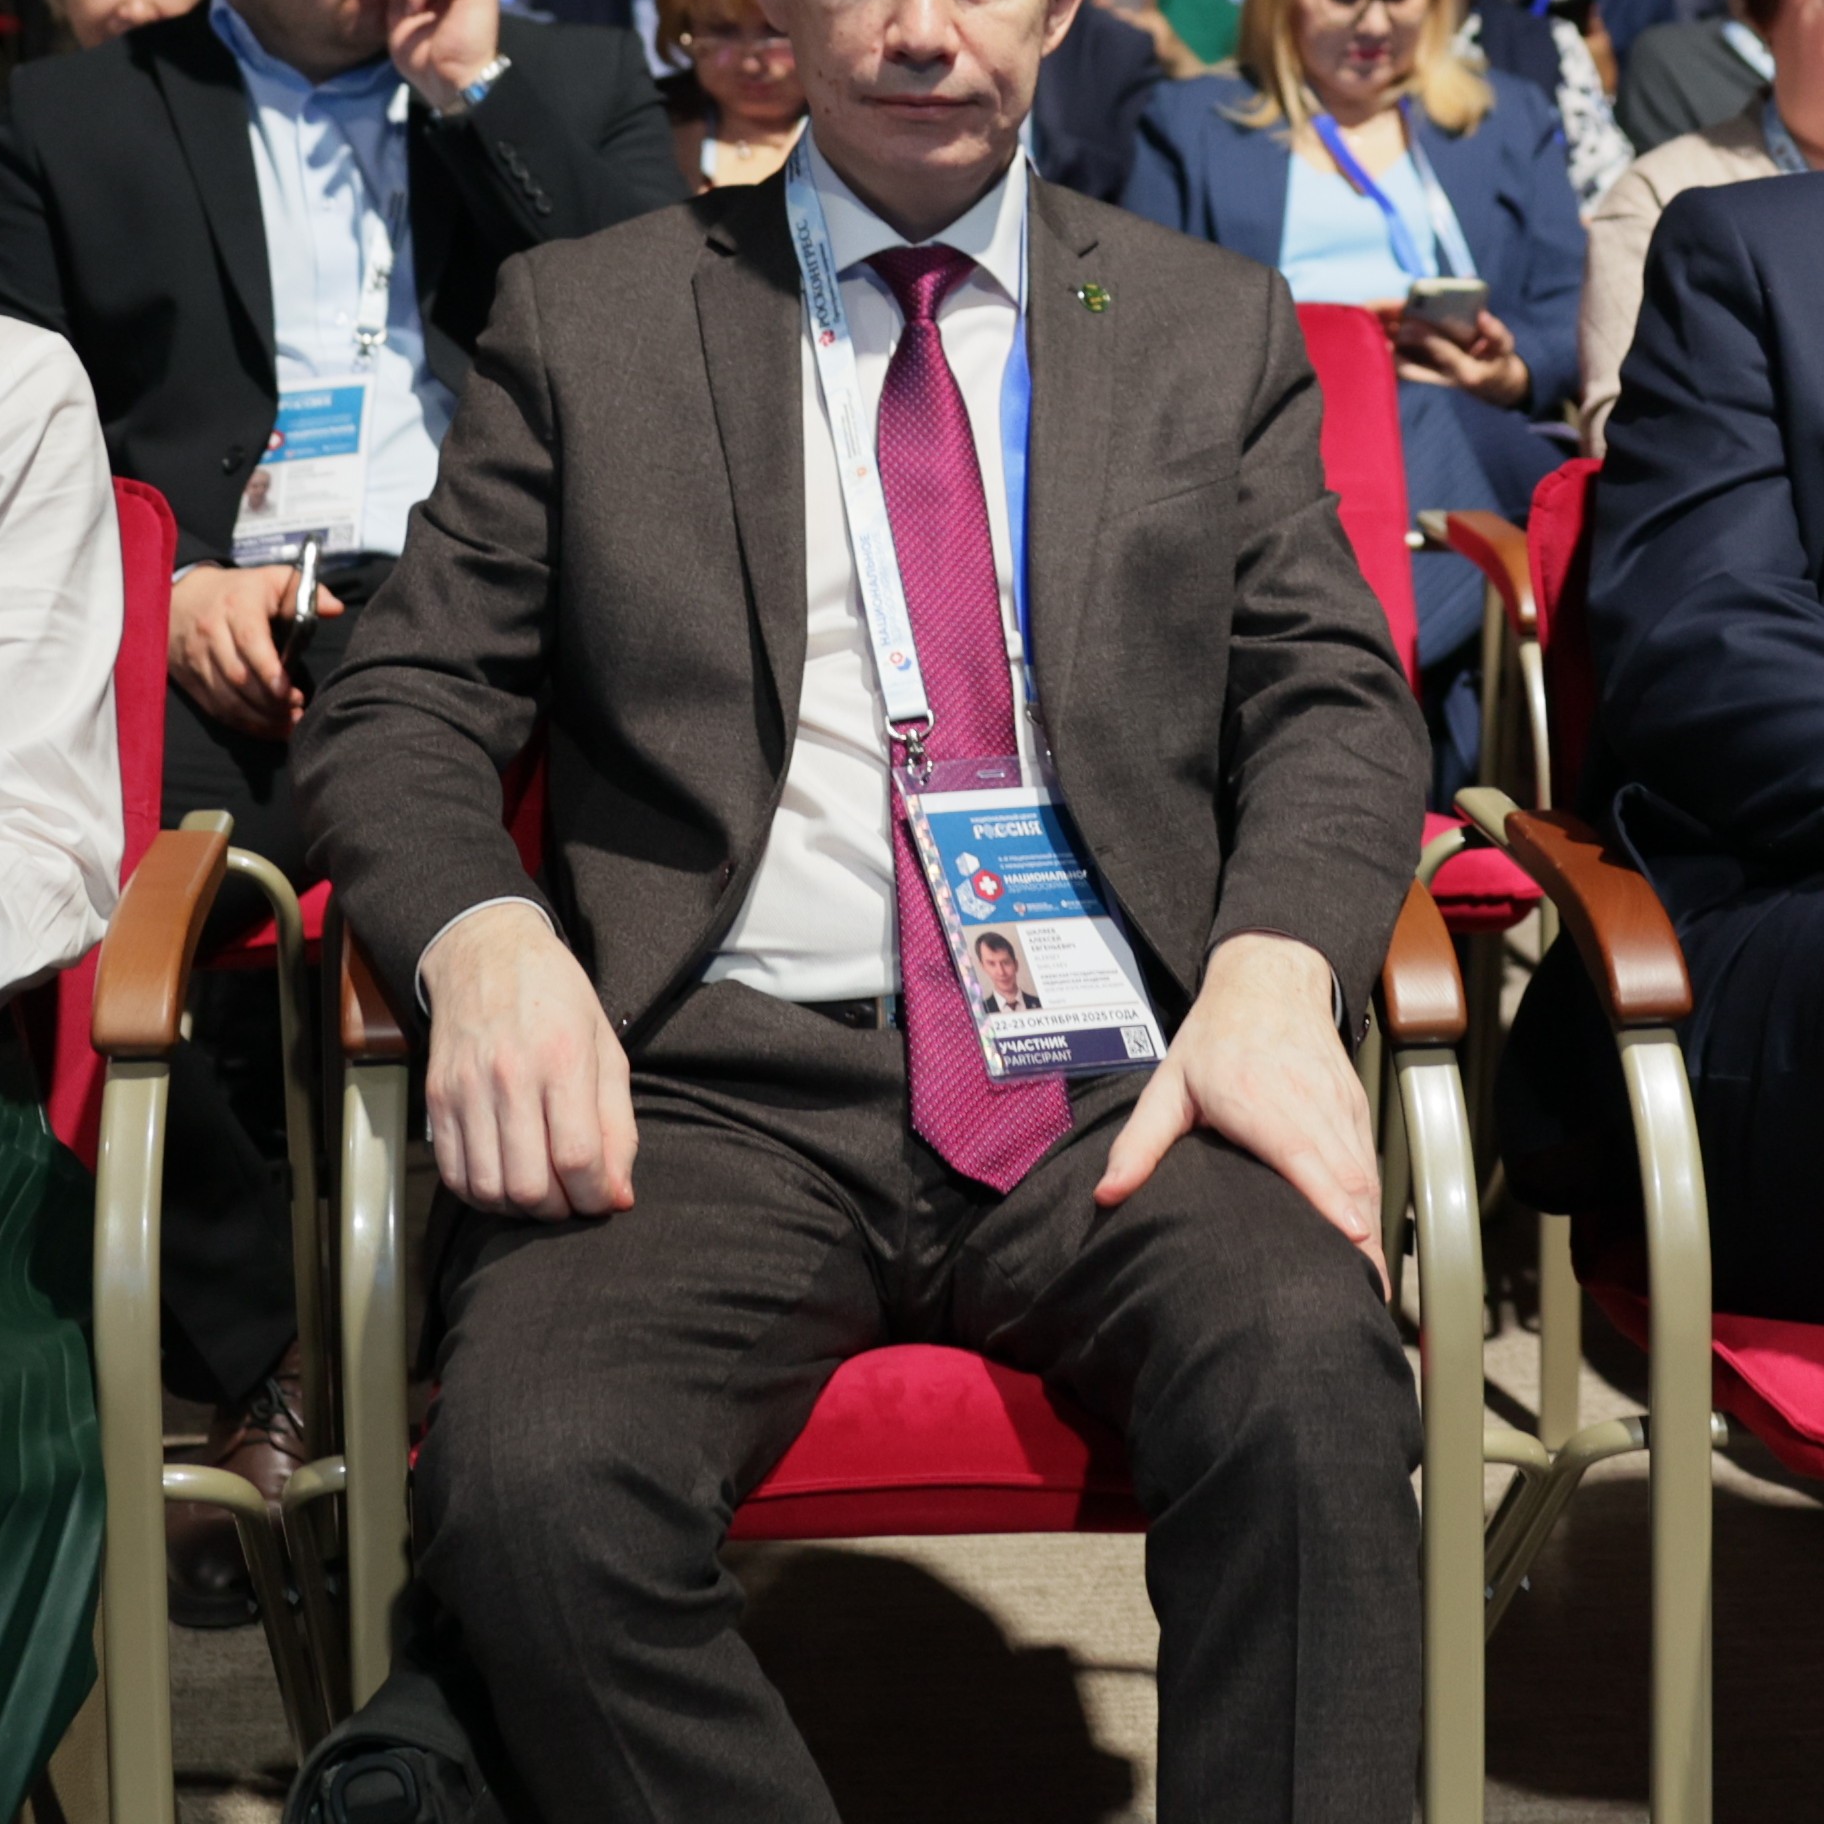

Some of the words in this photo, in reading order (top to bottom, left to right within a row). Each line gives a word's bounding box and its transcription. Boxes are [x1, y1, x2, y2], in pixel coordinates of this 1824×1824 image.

[796, 218, 831, 328] РОСКОНГРЕСС
[859, 533, 890, 646] НАЦИОНАЛЬНОЕ
[973, 820, 1044, 840] РОССИЯ
[994, 1018, 1026, 1031] 22-23
[1026, 1013, 1079, 1027] ОКТЯБРЯ
[1082, 1010, 1107, 1023] 2025
[1110, 1009, 1139, 1021] ГОДА
[999, 1035, 1068, 1055] УЧАСТНИК
[1004, 1049, 1072, 1067] PARTICIPANT
